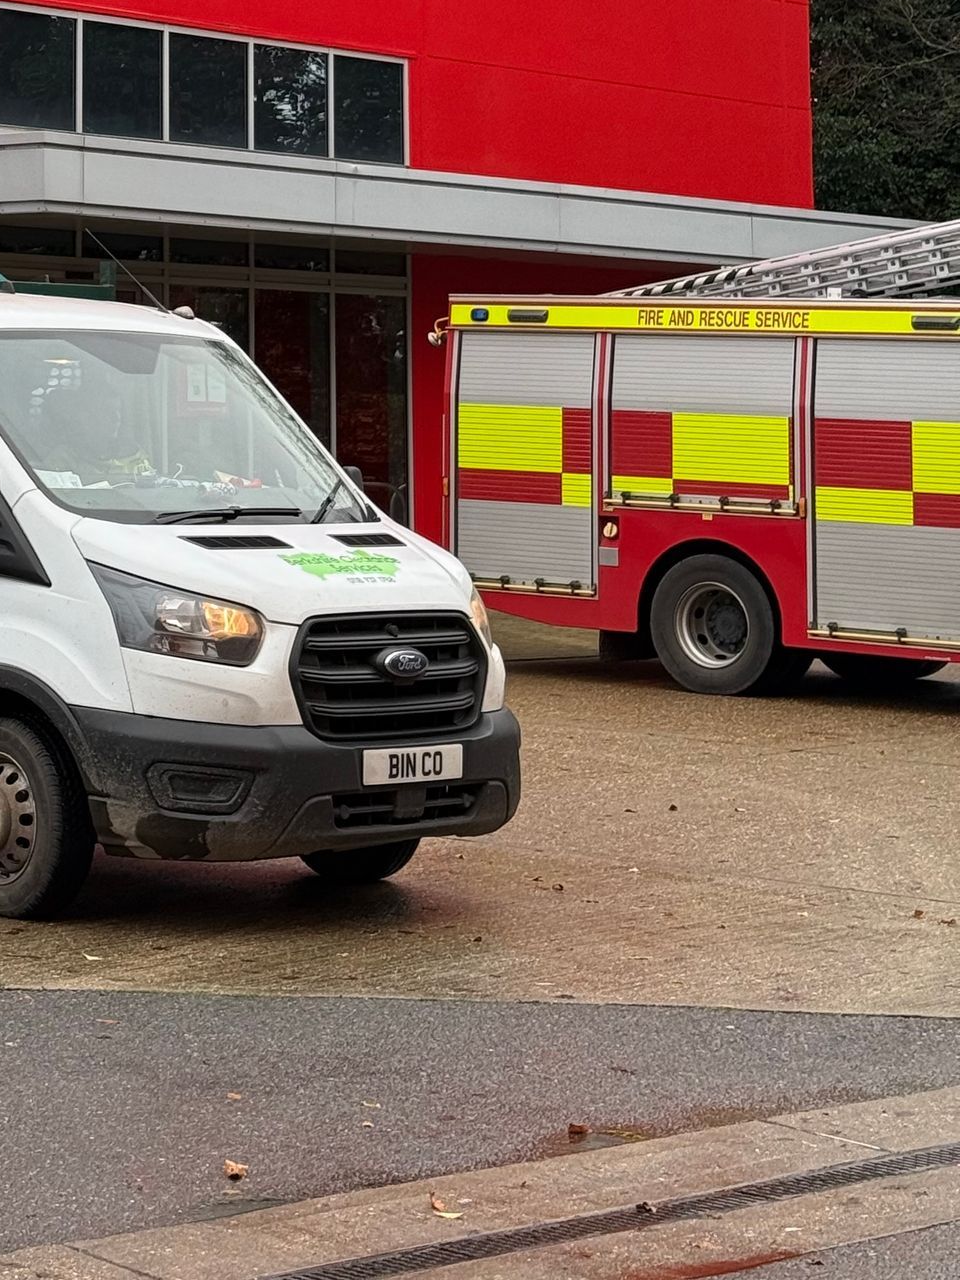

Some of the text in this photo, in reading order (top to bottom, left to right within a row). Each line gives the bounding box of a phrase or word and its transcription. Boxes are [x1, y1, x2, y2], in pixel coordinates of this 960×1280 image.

[638, 309, 810, 329] FIRE AND RESCUE SERVICE
[398, 654, 422, 670] Ford
[388, 751, 443, 779] BIN CO
